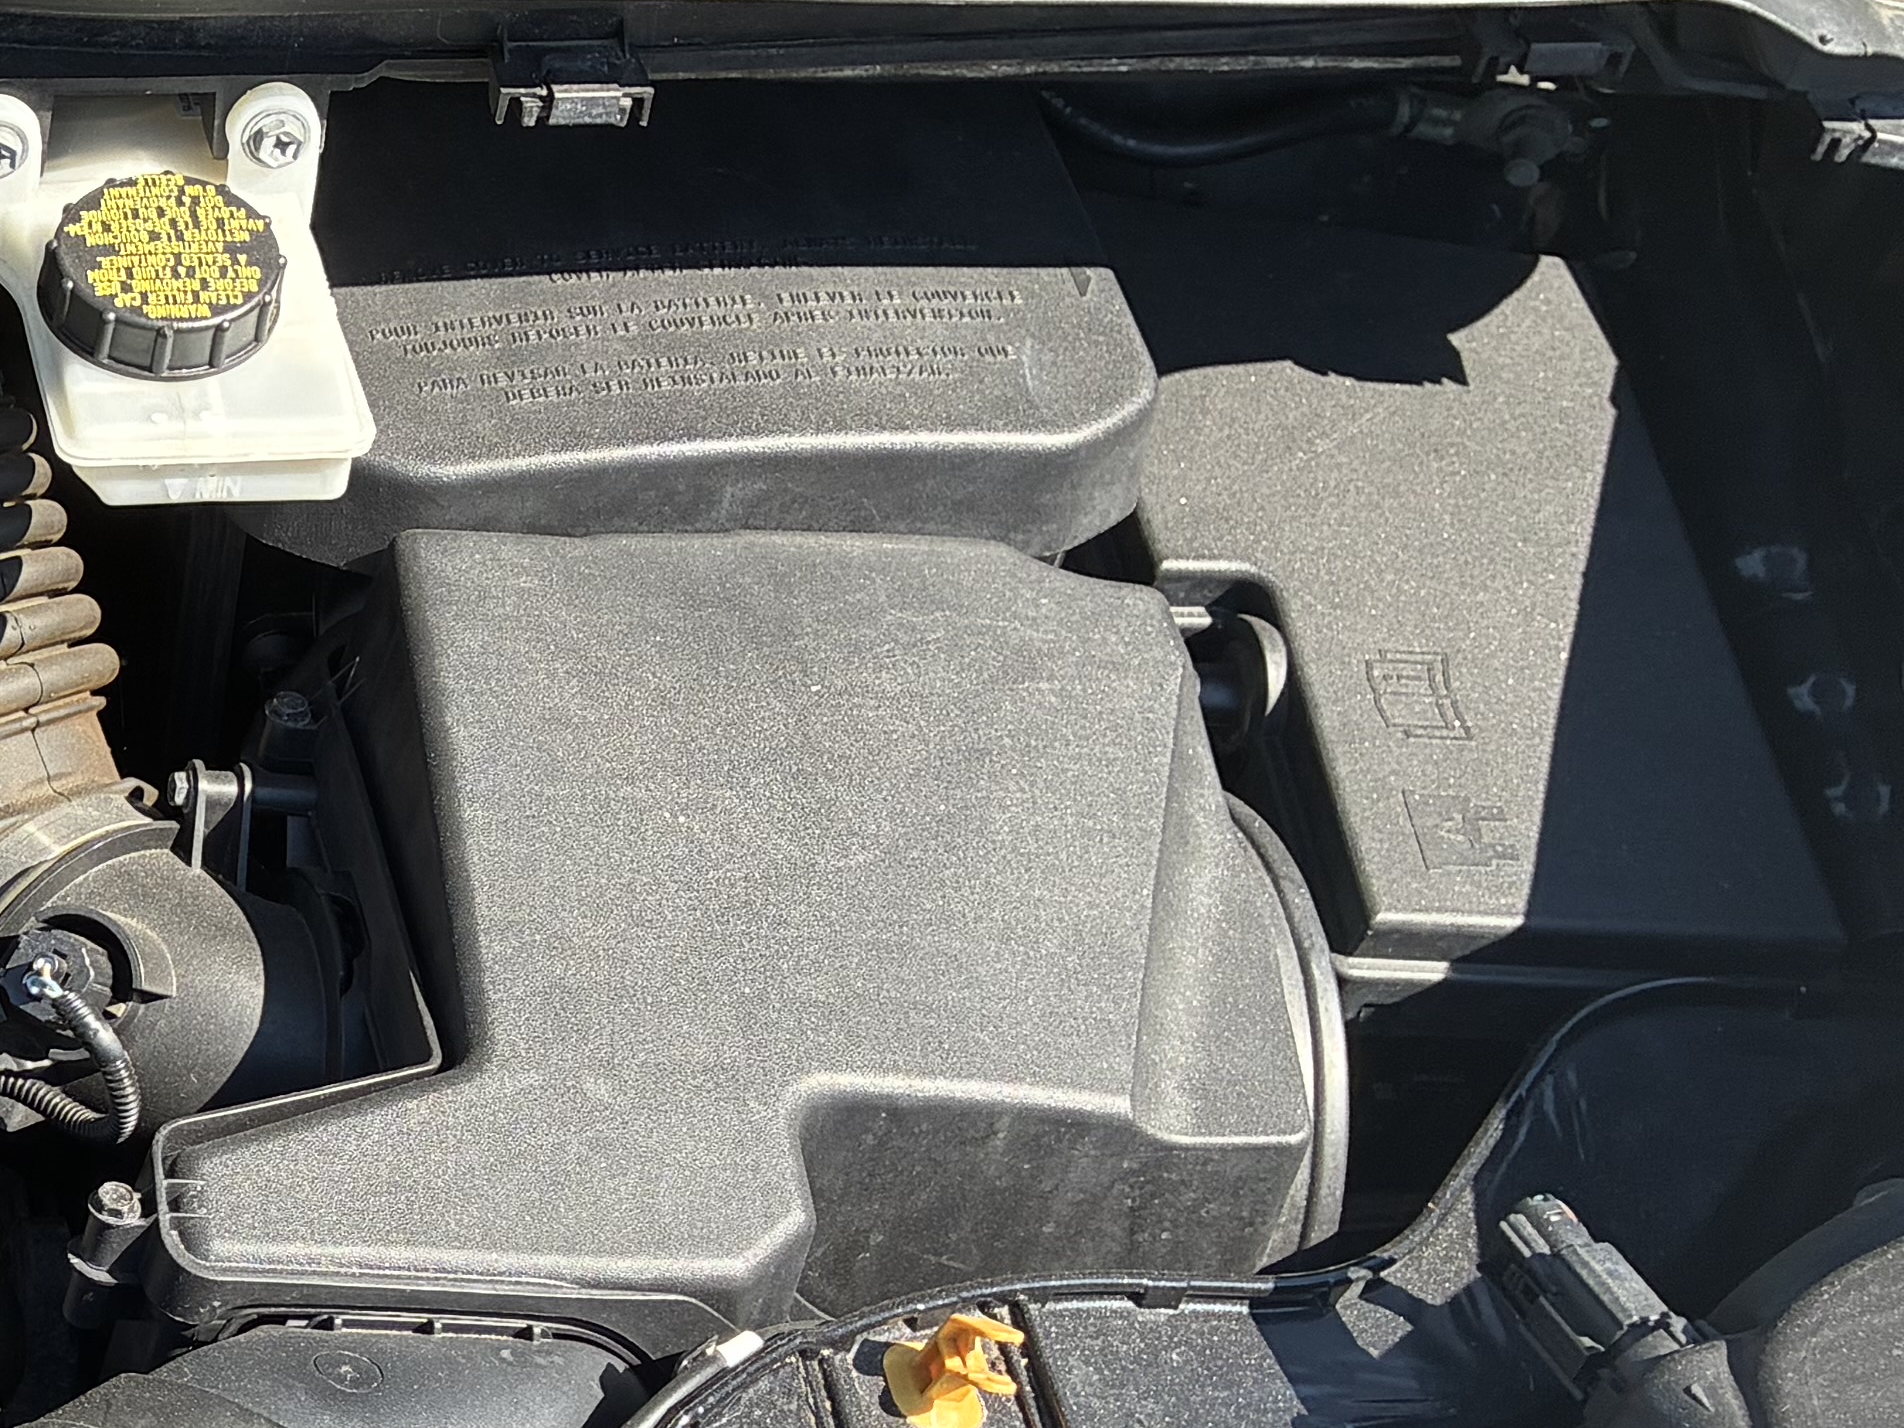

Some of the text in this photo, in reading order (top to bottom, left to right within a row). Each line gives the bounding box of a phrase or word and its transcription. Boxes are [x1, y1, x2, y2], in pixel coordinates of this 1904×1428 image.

[103, 185, 179, 200] CONTENANT
[100, 196, 176, 211] PROVENANT
[199, 195, 225, 208] DOT
[176, 218, 193, 232] LE
[199, 218, 218, 231] DE
[223, 218, 265, 233] AVANT
[183, 229, 251, 243] NETTOYER
[180, 253, 232, 267] SEALED
[237, 253, 248, 266] A
[86, 267, 127, 284] FROM
[131, 266, 172, 280] FLUID
[194, 265, 220, 279] DOT
[226, 264, 262, 280] ONLY
[93, 280, 122, 297] USE
[207, 277, 259, 292] BEFORE
[114, 290, 244, 308] CLEAN FILLER CAP
[368, 323, 419, 343] POUR
[431, 307, 557, 335] INTERVENIR
[565, 302, 607, 320] SUR
[615, 300, 644, 316] LA
[775, 290, 865, 306] ENLEVER
[911, 288, 1024, 305] COUVERCLE
[400, 333, 502, 359] TOUJOURS
[509, 323, 601, 345] REPOSER
[647, 312, 761, 333] COUVERCLE
[416, 376, 470, 395] PARA
[478, 364, 569, 388] REVISAR
[579, 361, 607, 377] LA
[590, 378, 632, 396] SER
[641, 369, 782, 392] REINSTALADO
